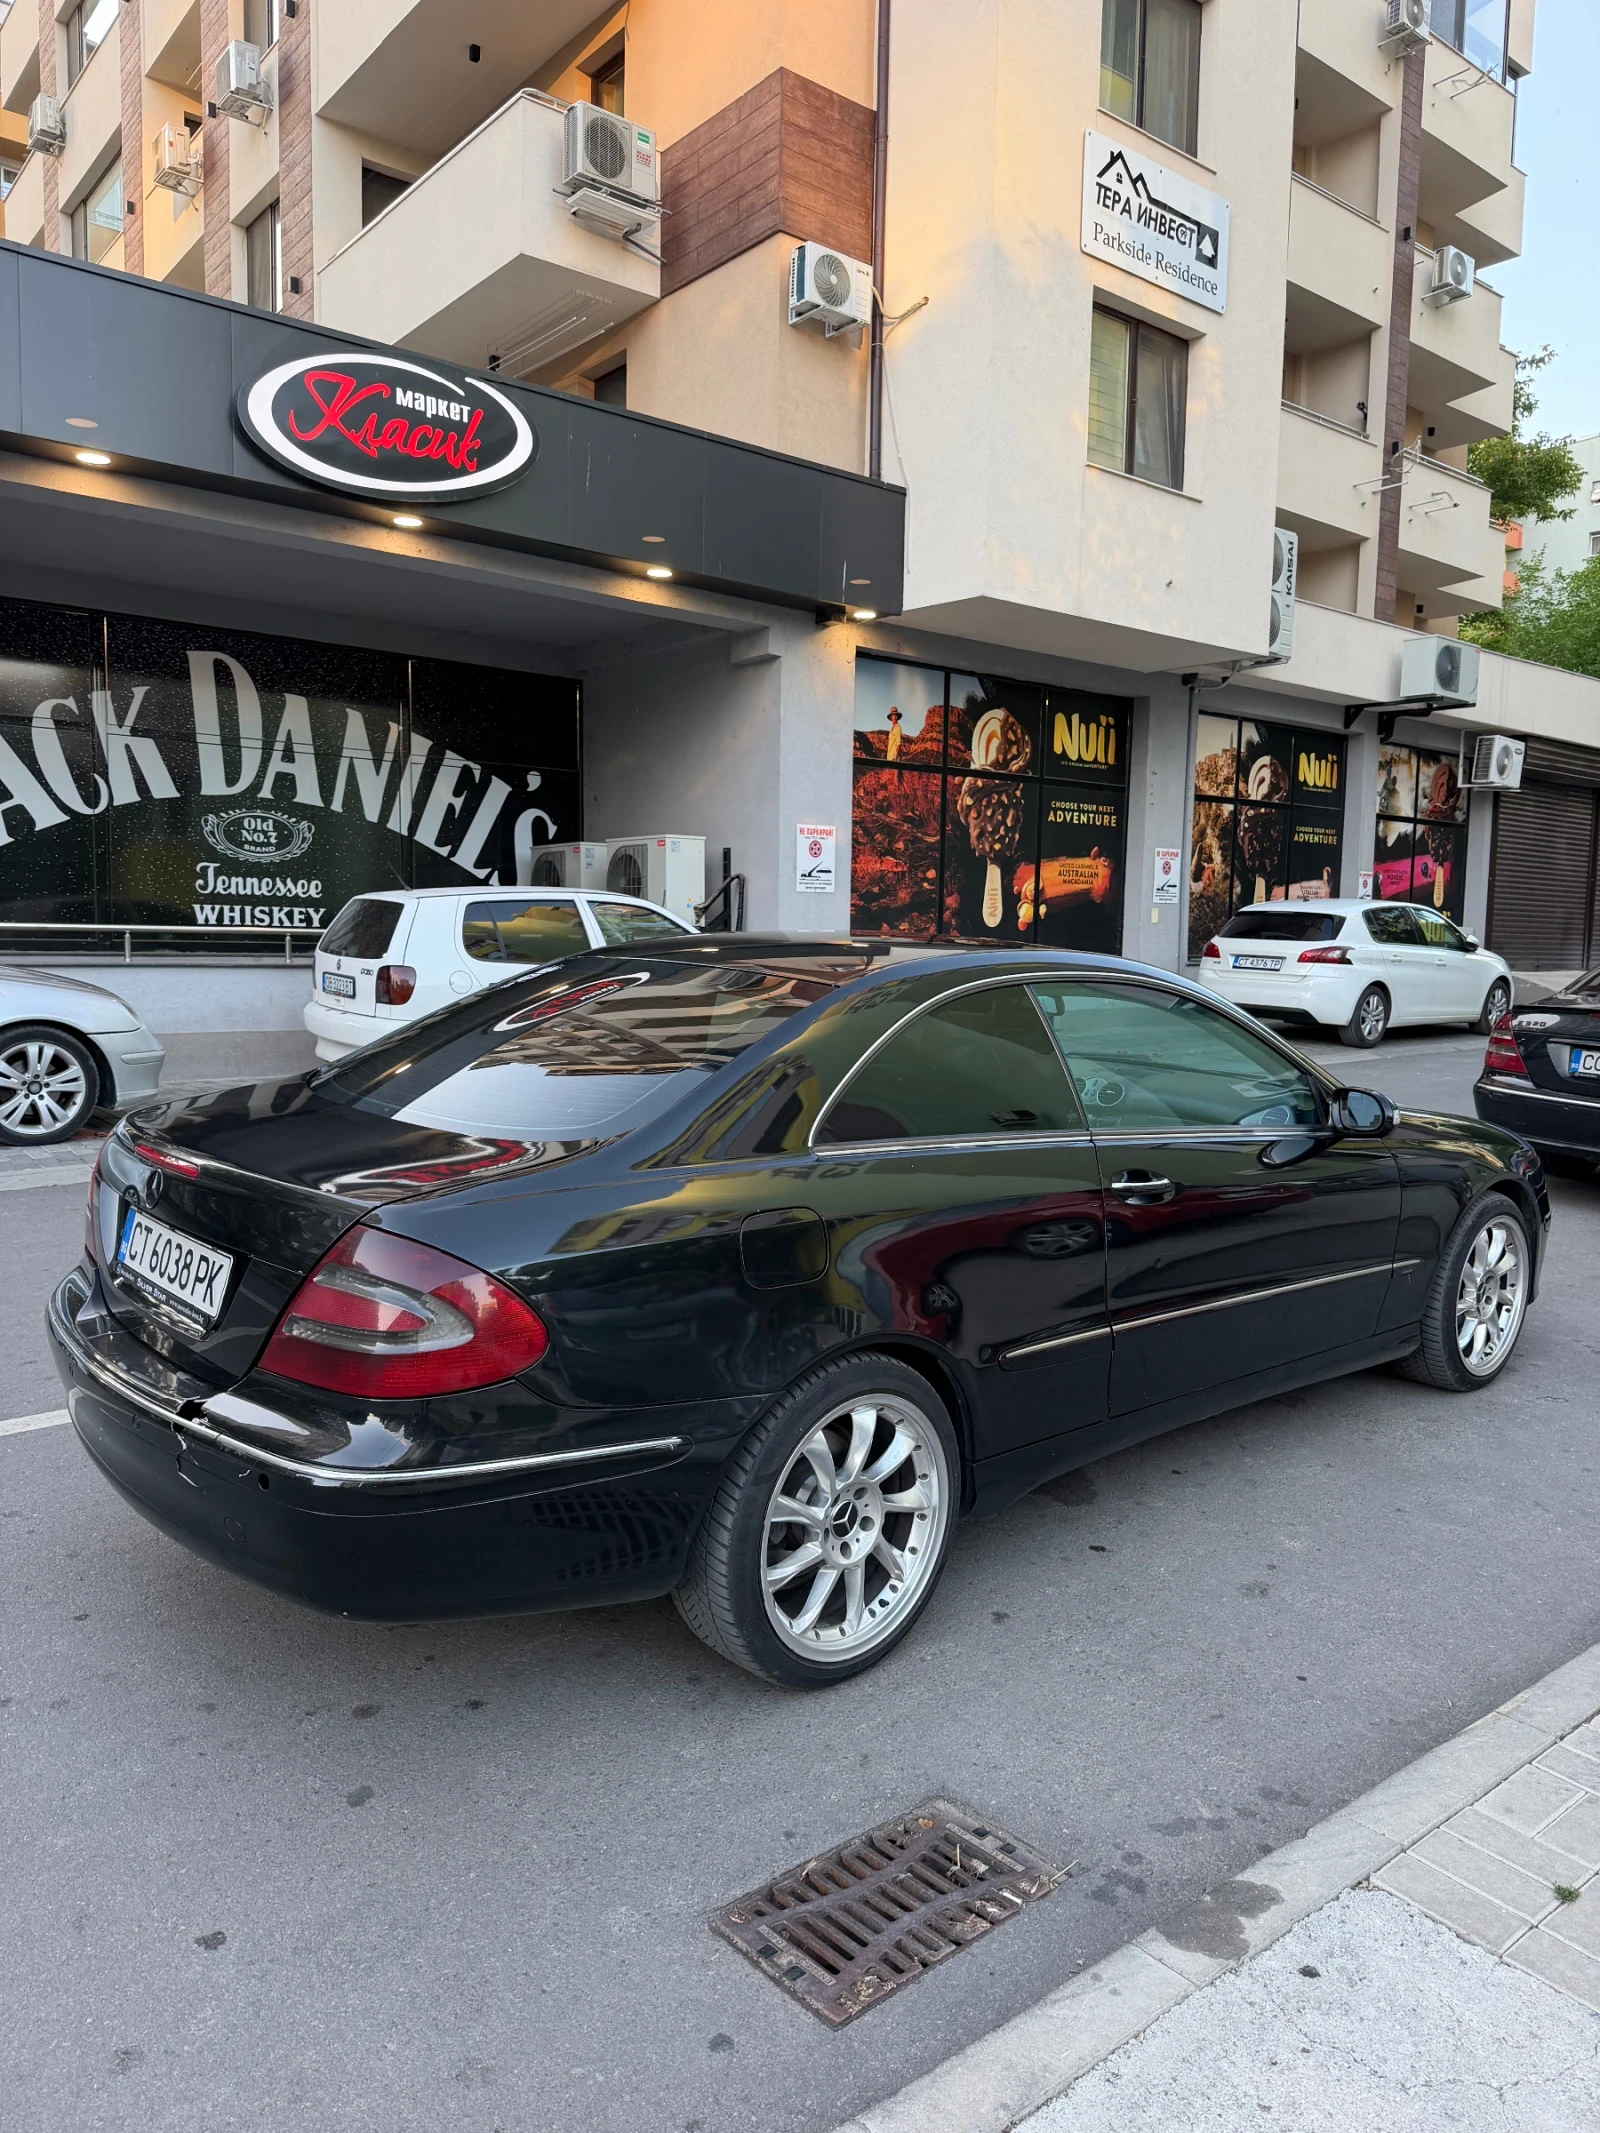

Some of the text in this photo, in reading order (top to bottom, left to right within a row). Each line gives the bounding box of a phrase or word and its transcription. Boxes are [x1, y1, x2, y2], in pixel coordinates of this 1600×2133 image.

[1137, 203, 1195, 249] ИНВЕСТ
[1093, 222, 1218, 296] Parkside Residence
[395, 387, 471, 424] маркет
[288, 370, 484, 473] Класик
[1285, 540, 1294, 596] KAISAI
[1053, 712, 1116, 765] Nuii
[1298, 752, 1338, 789] Nuii
[1047, 810, 1117, 827] ADVENTURE
[1051, 801, 1078, 809] CHOOSE
[1079, 803, 1097, 811] YOUR
[243, 817, 274, 831] Old
[243, 844, 276, 853] BRAND
[1293, 833, 1337, 845] ADVENTURE
[195, 862, 323, 898] Tennessee
[1057, 870, 1099, 879] AUSTRALIAN
[192, 904, 326, 927] WHISKEY
[1238, 958, 1280, 968] CT 4376 TP
[129, 1221, 224, 1308] CT 6038 PK
[153, 1288, 167, 1302] STAR
